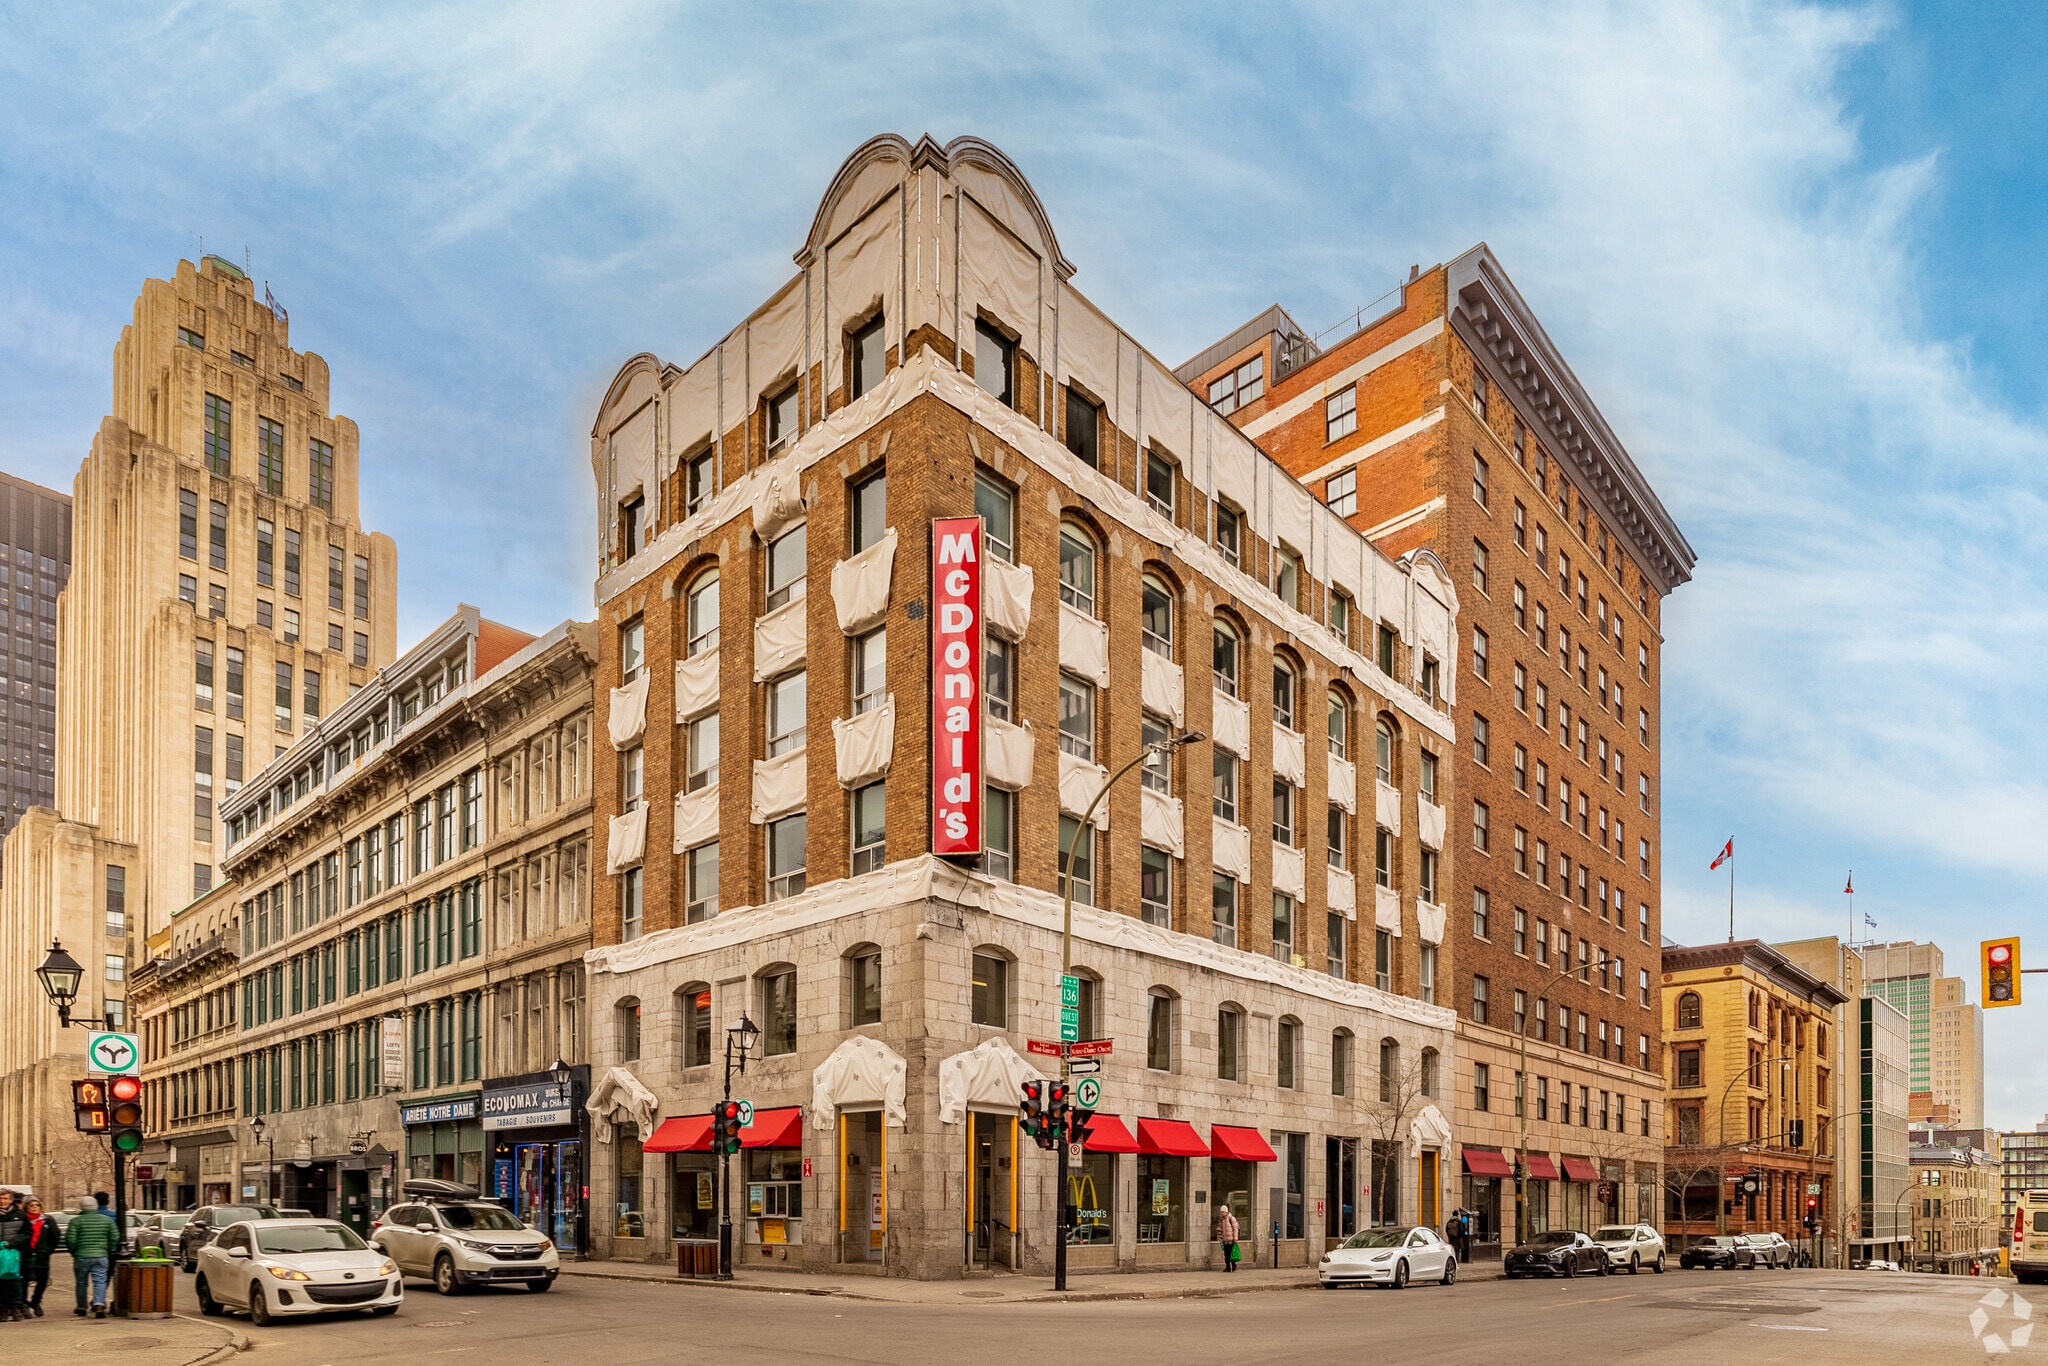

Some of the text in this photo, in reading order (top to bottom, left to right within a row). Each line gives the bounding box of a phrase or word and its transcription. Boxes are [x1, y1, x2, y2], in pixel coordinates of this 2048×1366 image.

[938, 533, 976, 840] McDonald's
[1063, 988, 1077, 1002] 136
[1061, 1010, 1078, 1022] OUEST
[1070, 1046, 1096, 1055] Notre-Dame
[1097, 1045, 1112, 1053] Ouest
[484, 1092, 539, 1113] ECONOMAX
[429, 1105, 451, 1120] NOTRE
[453, 1102, 474, 1117] DAME
[496, 1118, 518, 1127] TABAGIE
[525, 1113, 556, 1125] SOUVENIRS
[1077, 1208, 1107, 1219] Donald's
